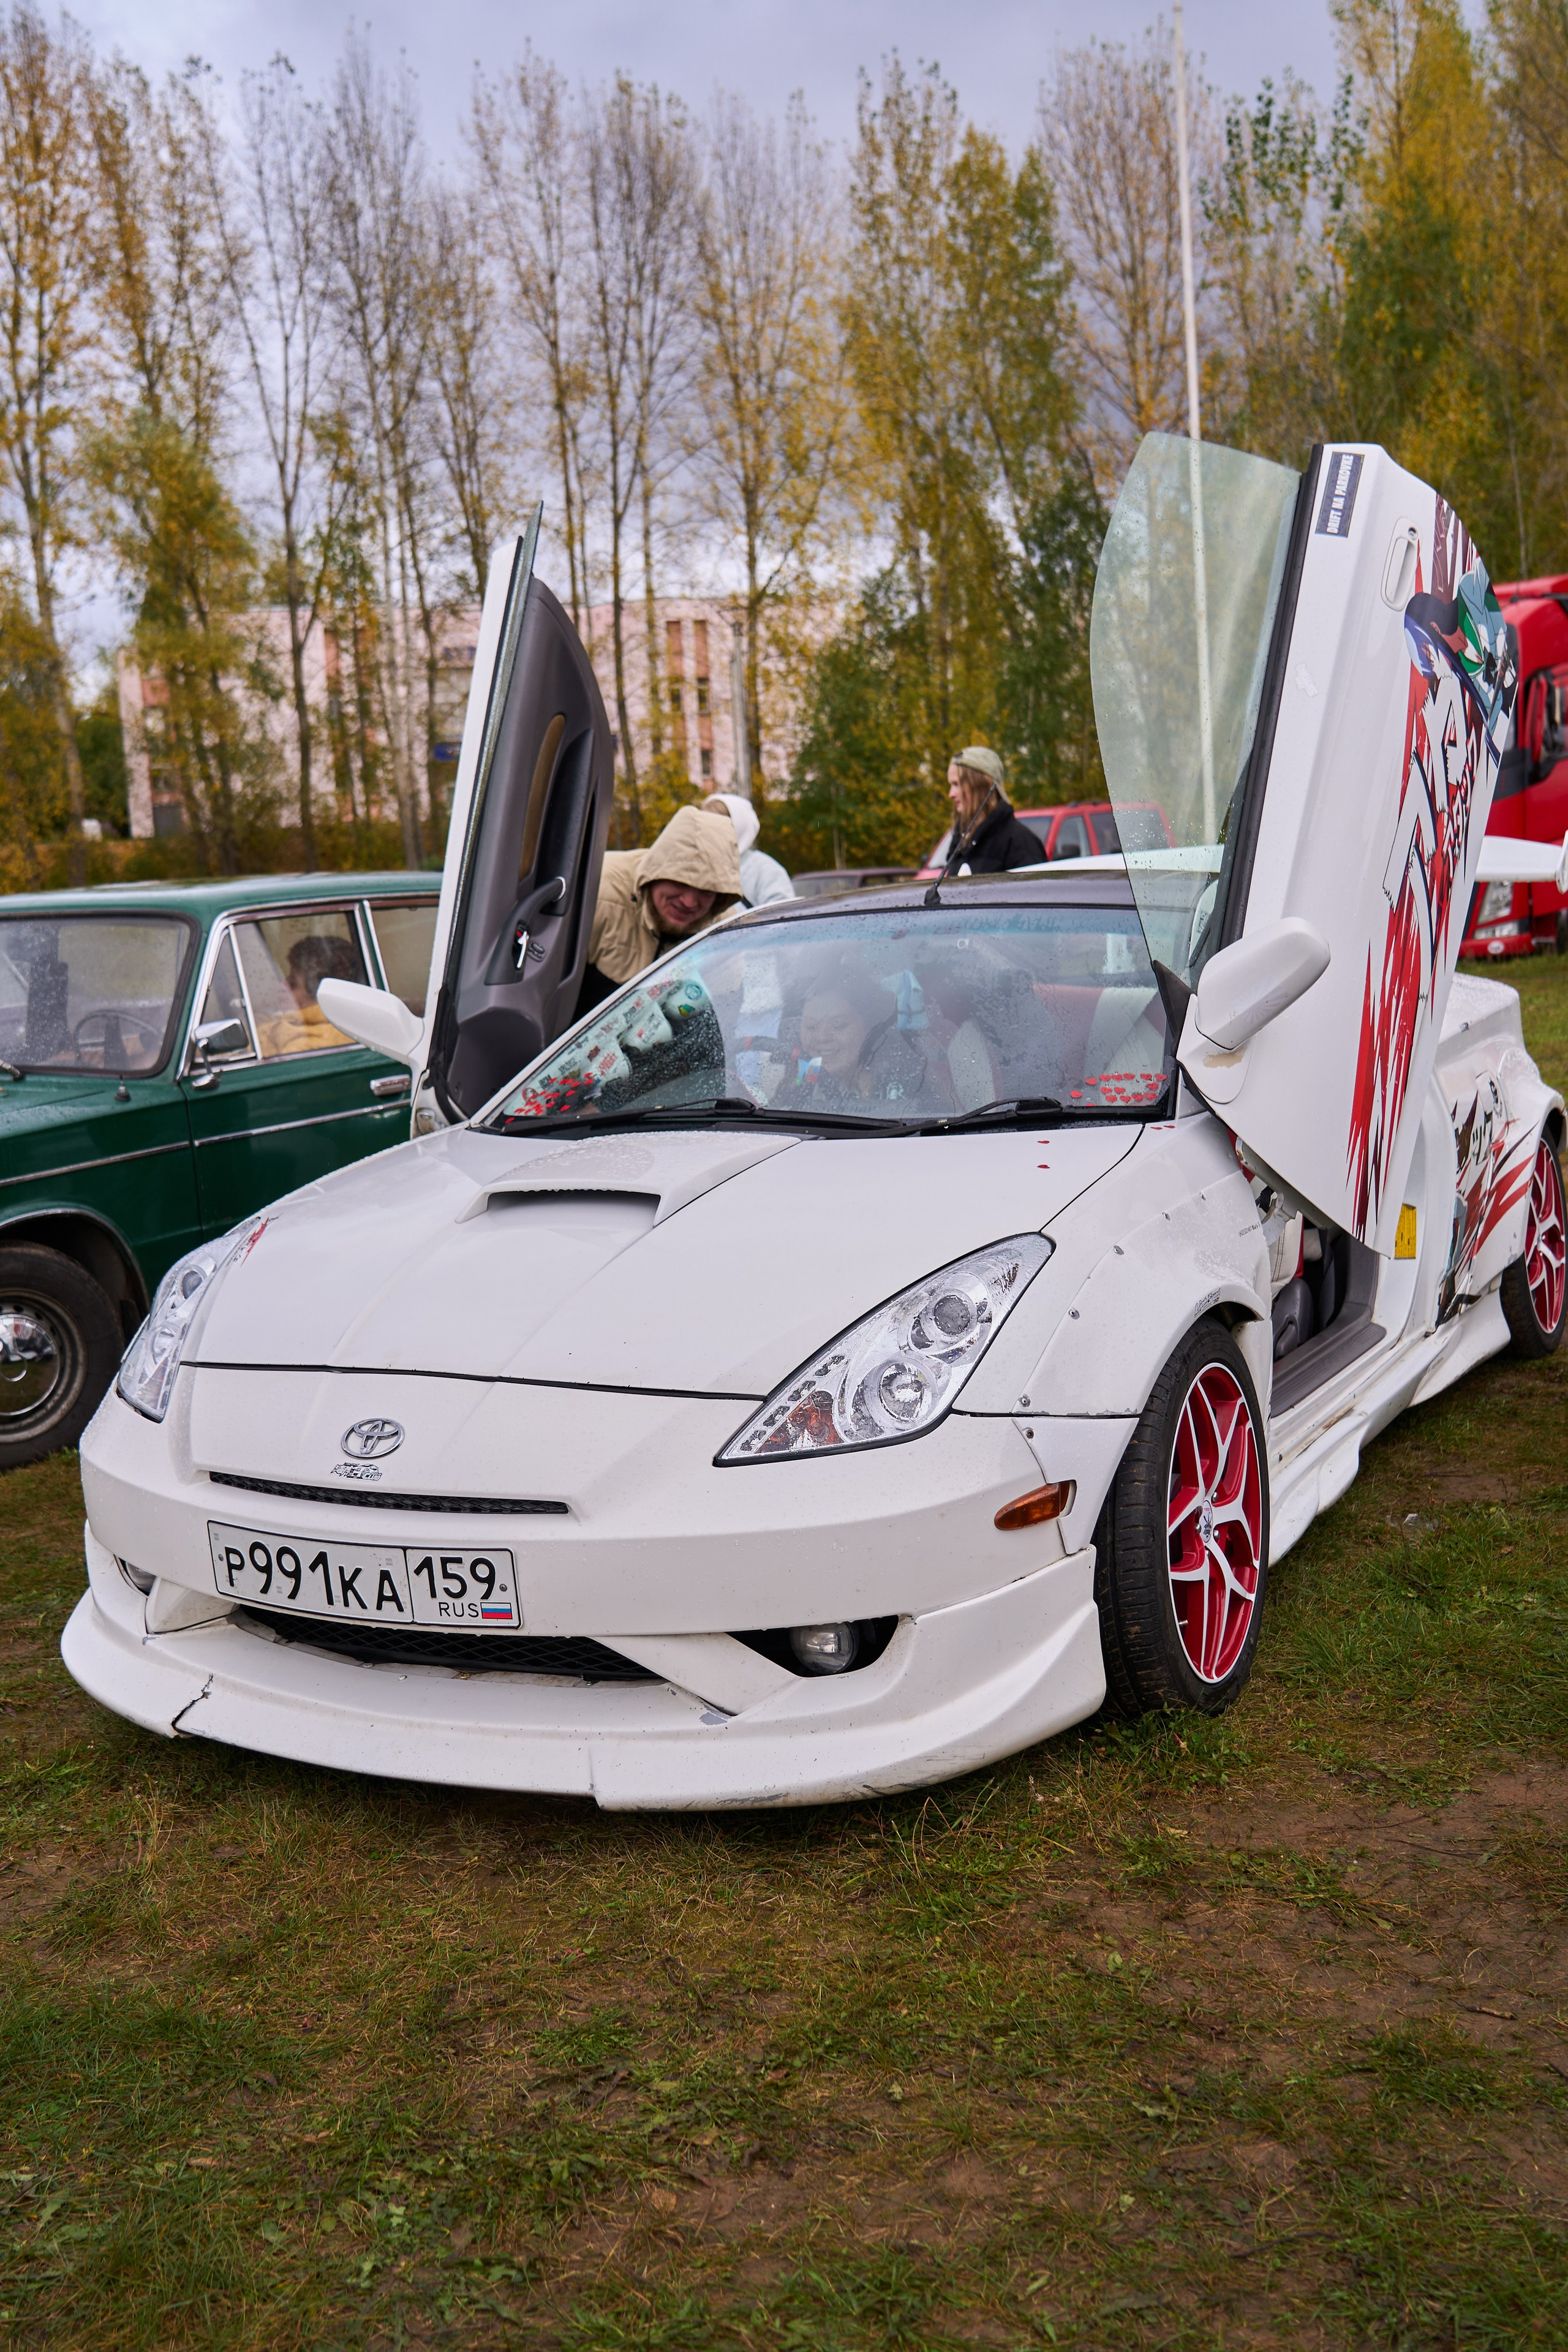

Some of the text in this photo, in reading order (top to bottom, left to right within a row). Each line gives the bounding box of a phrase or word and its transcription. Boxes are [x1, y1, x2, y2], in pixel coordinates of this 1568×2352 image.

[1327, 454, 1354, 533] DRIFT NA PARKOVKE
[413, 1556, 496, 1600] 159
[439, 1602, 479, 1617] RUS
